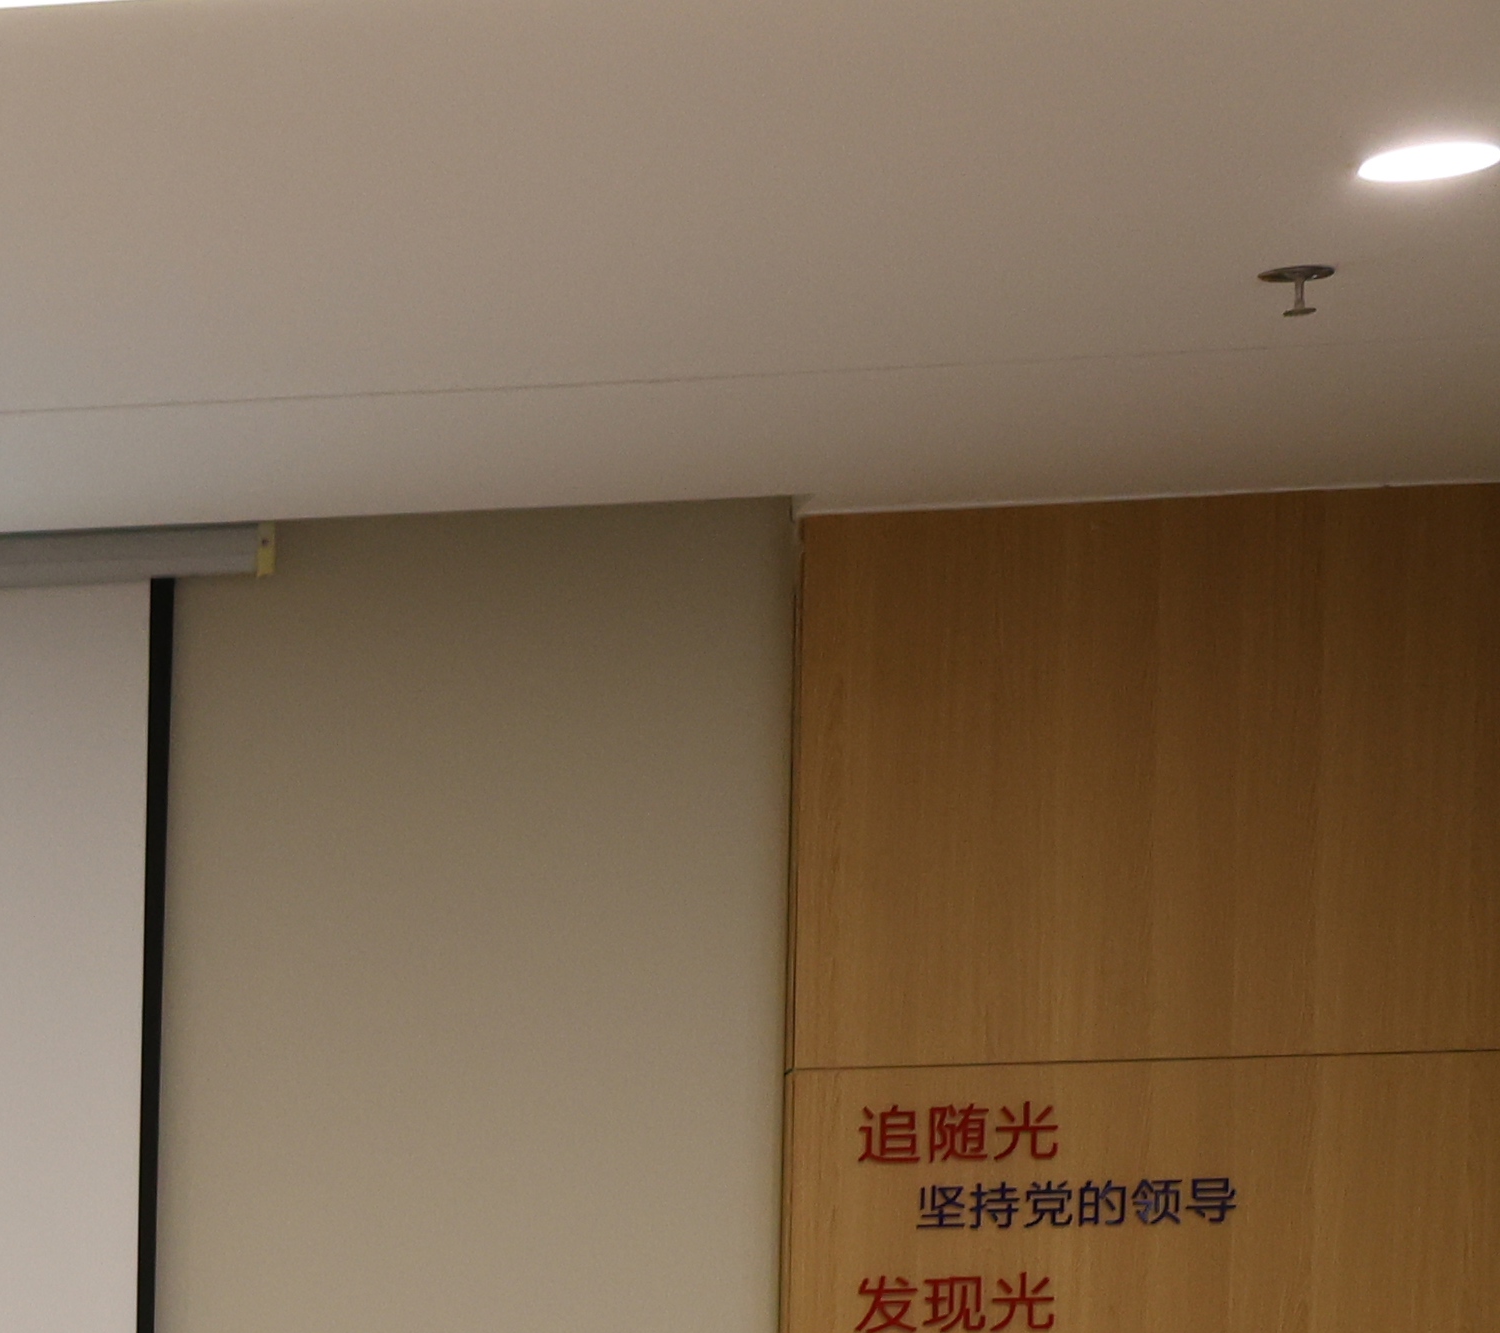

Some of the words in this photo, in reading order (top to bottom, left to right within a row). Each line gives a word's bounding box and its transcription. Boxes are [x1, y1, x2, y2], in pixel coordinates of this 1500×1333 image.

[858, 1101, 1059, 1164] 追随光
[916, 1177, 1237, 1230] 坚持党的领导
